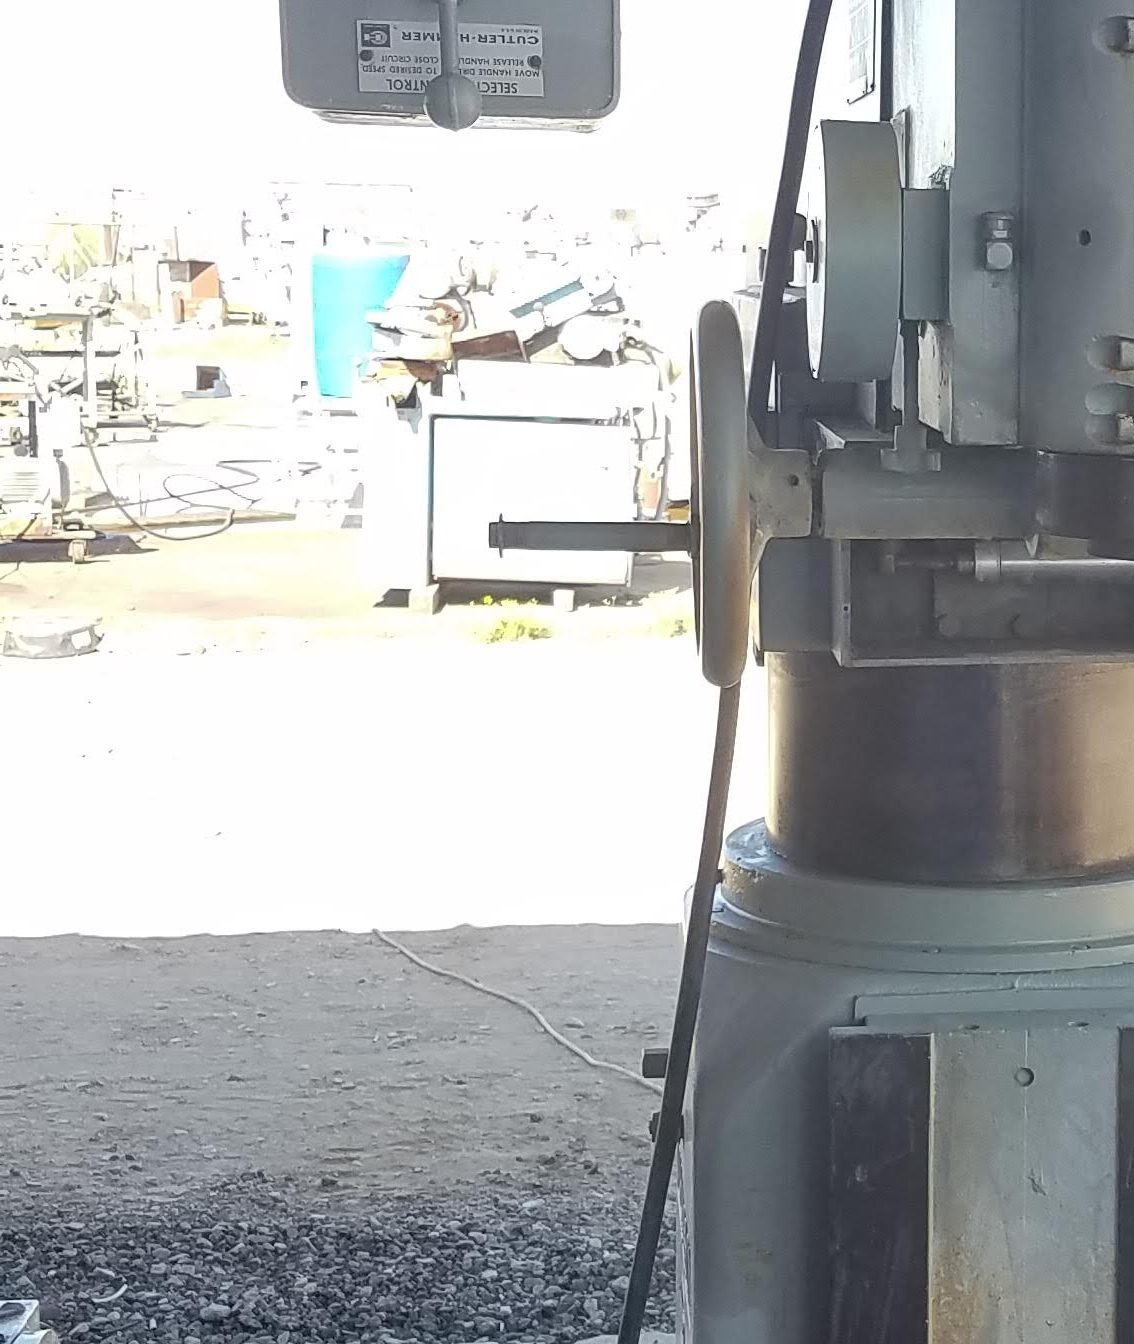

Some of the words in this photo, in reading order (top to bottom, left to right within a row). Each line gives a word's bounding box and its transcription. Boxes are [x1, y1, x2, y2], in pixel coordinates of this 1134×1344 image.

[381, 55, 411, 63] CIRCUIT
[415, 56, 439, 64] CLOSE
[493, 58, 524, 67] RELEASE
[389, 66, 422, 74] DESIRED
[478, 68, 512, 77] HANDLE
[514, 69, 540, 78] MOVE
